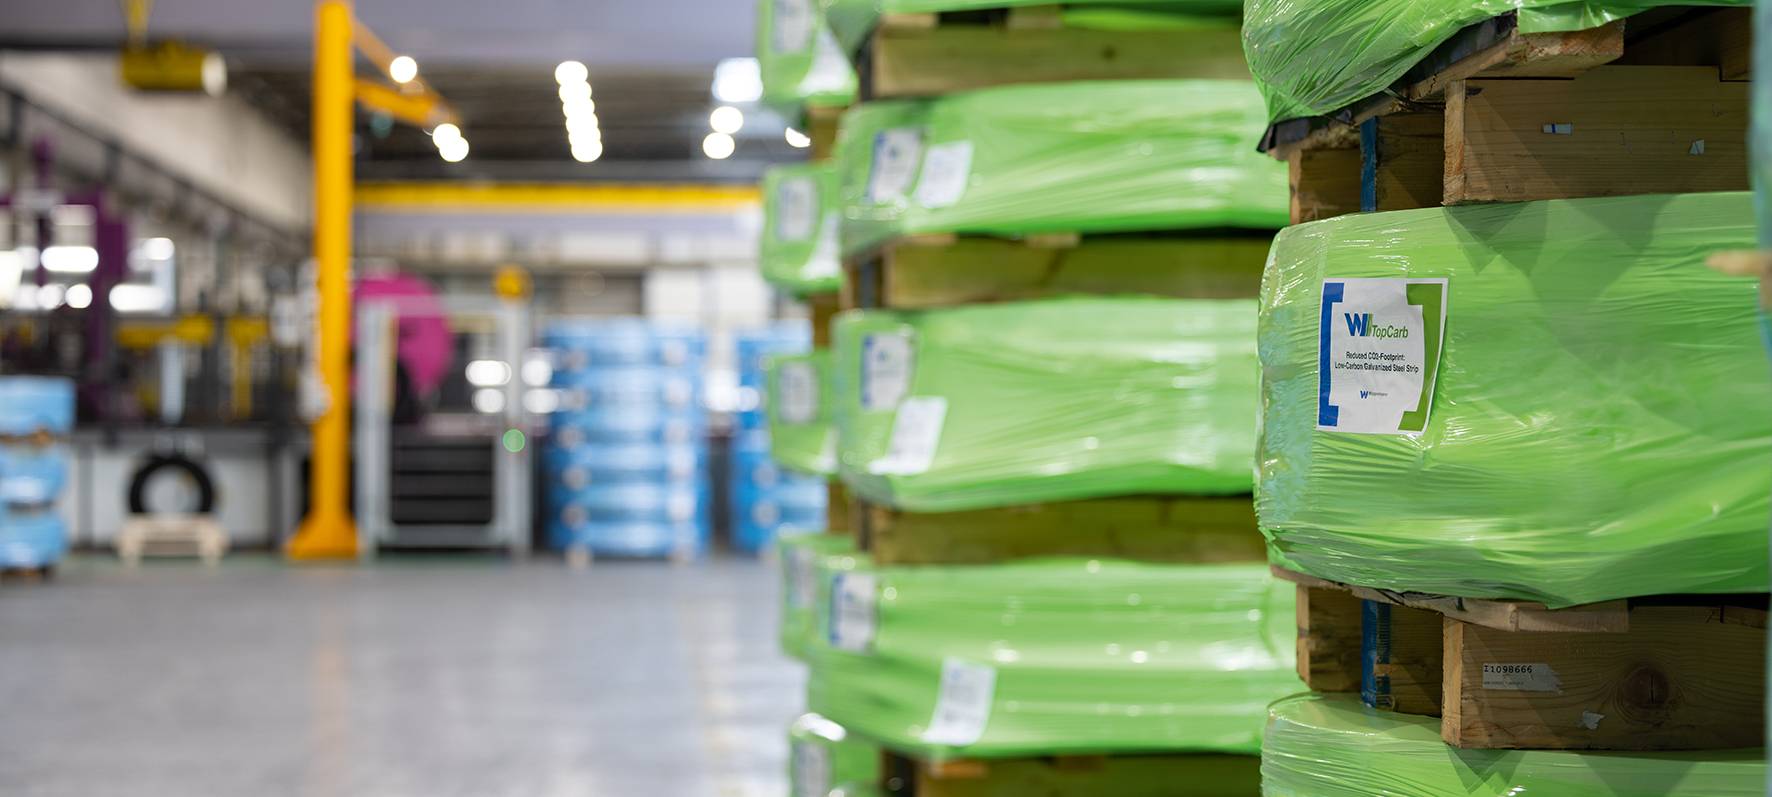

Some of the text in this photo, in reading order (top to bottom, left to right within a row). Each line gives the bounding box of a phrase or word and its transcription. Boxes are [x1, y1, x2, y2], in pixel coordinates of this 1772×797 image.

[1372, 324, 1408, 340] TopCarb
[1346, 351, 1367, 360] Reduced
[1334, 361, 1419, 374] Low-Carbon Galvanized Steel Strip
